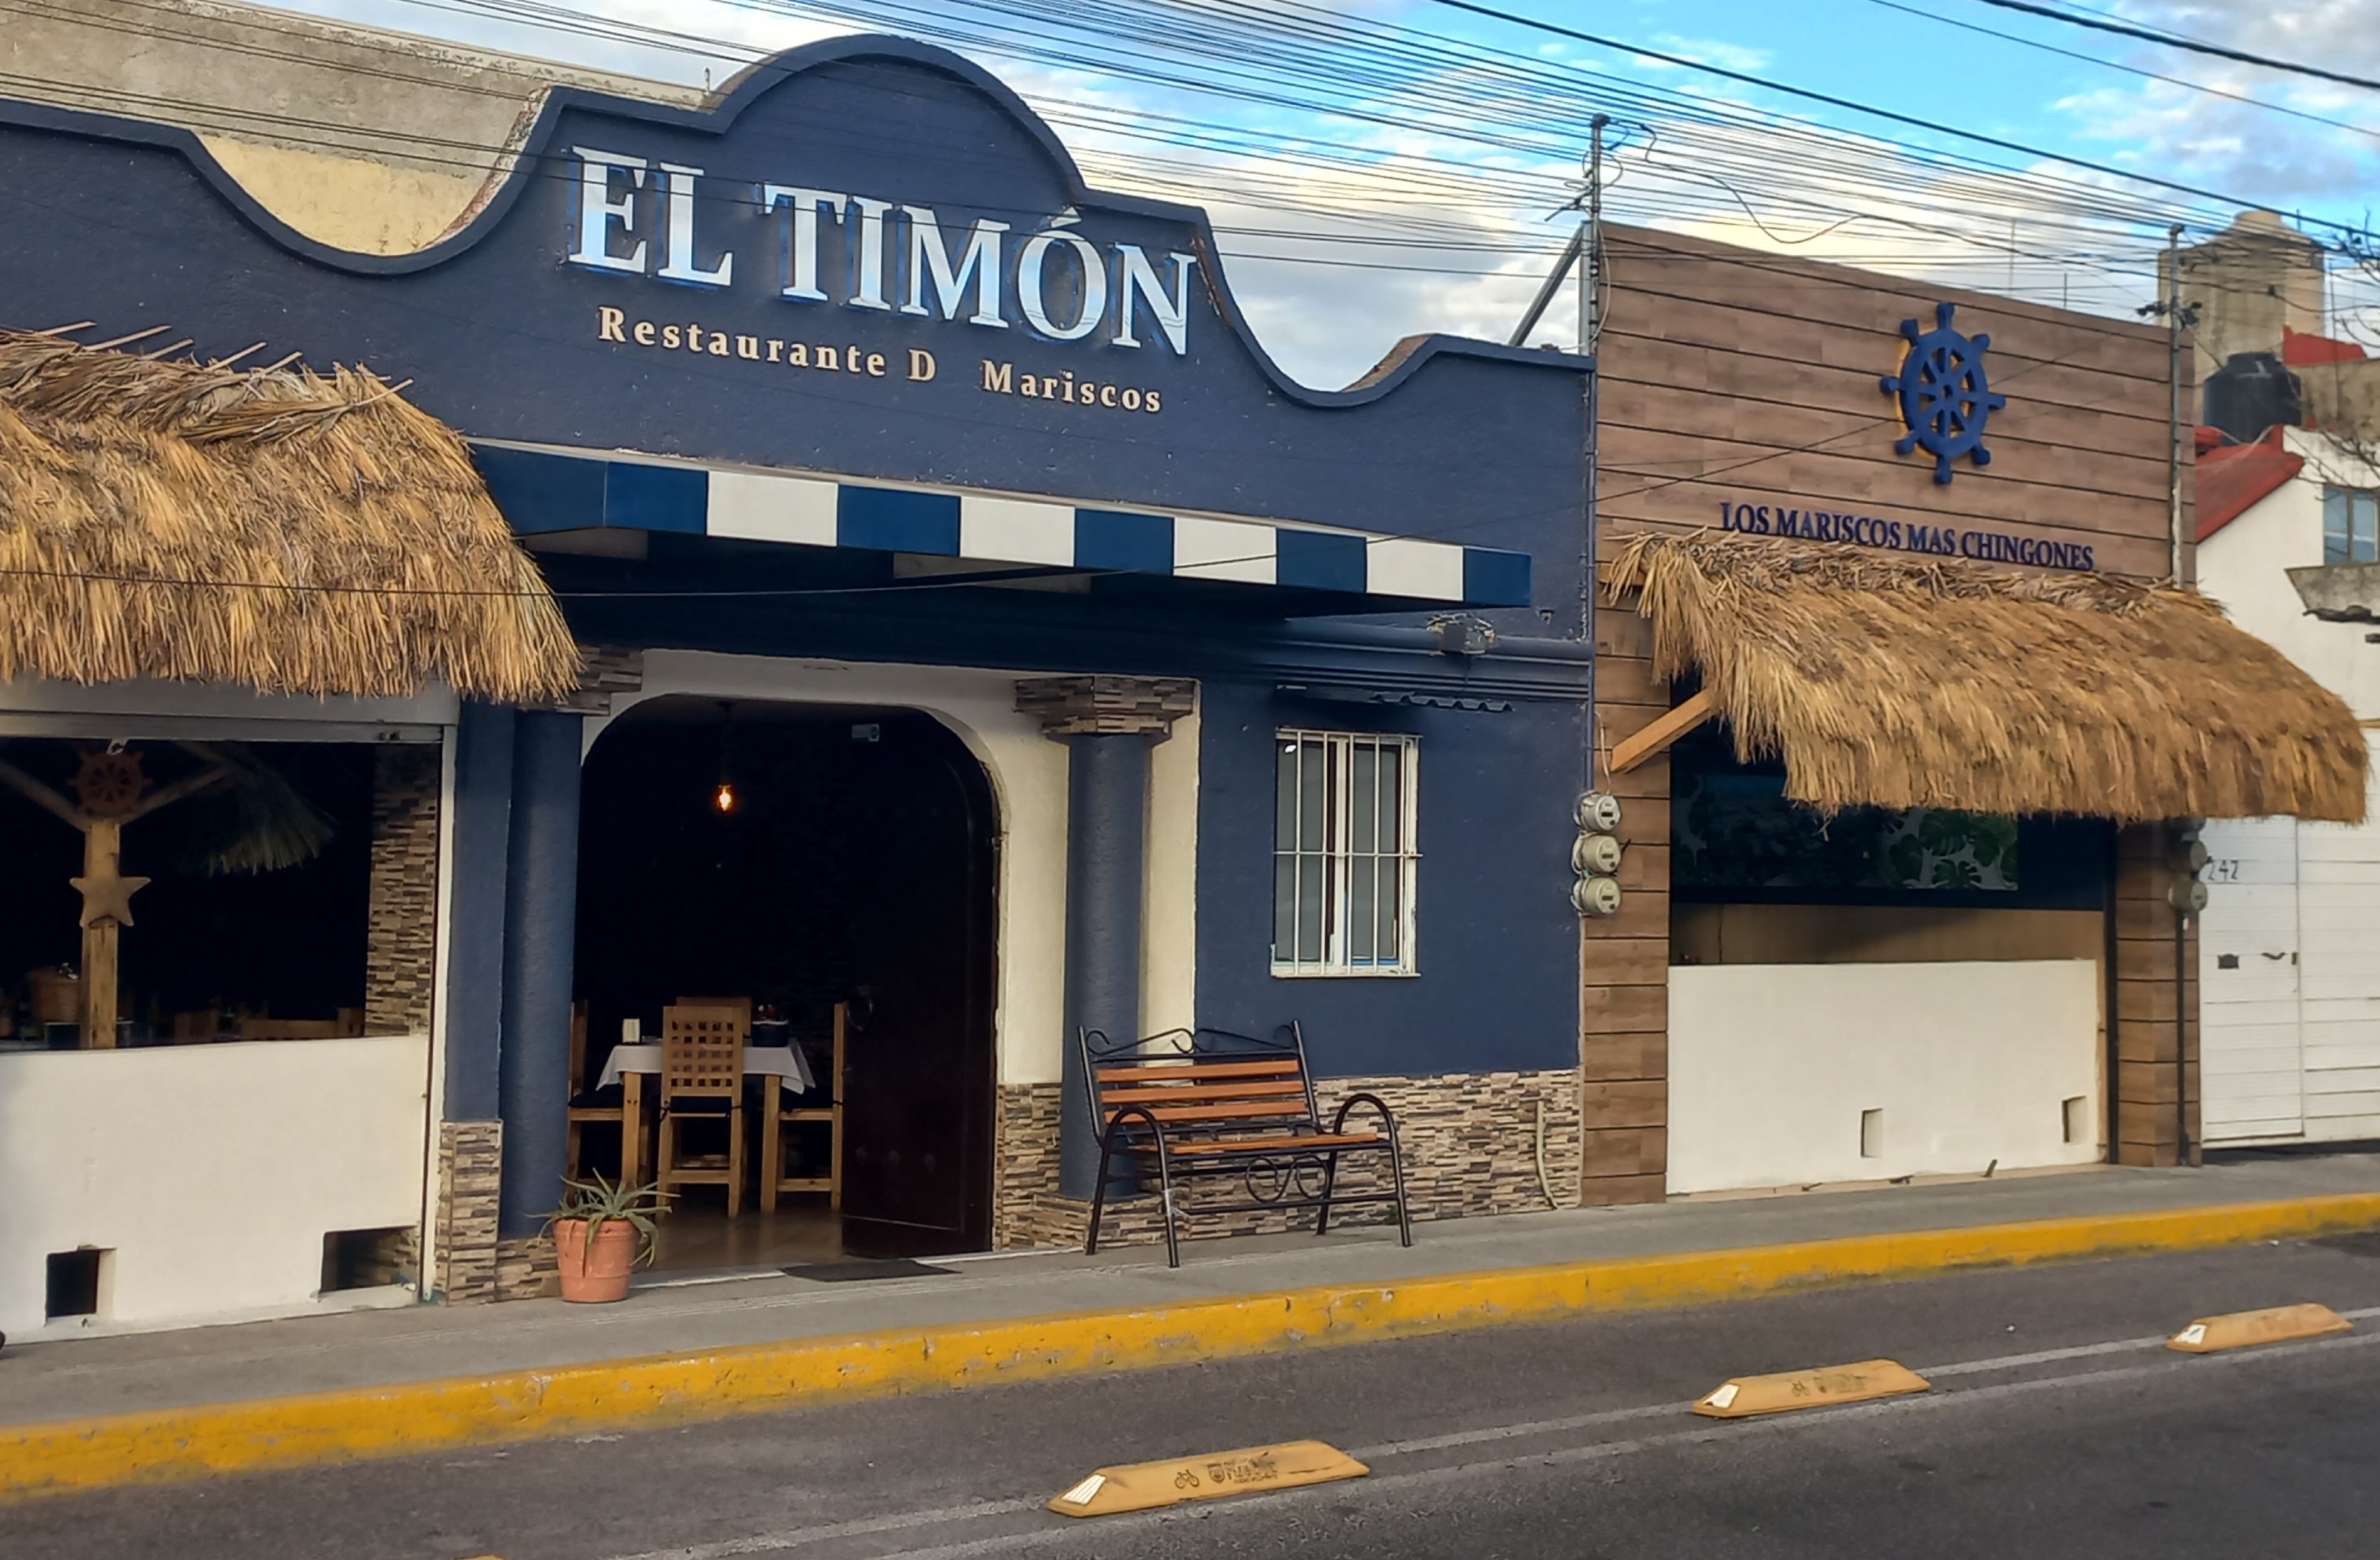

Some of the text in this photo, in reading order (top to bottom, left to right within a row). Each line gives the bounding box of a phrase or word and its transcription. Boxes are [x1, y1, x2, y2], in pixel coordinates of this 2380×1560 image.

[568, 144, 1197, 356] EL TIMÓN
[598, 306, 1161, 413] Restaurante D Mariscos
[1721, 502, 2094, 572] LOS MARISCOS MAS CHINGONES
